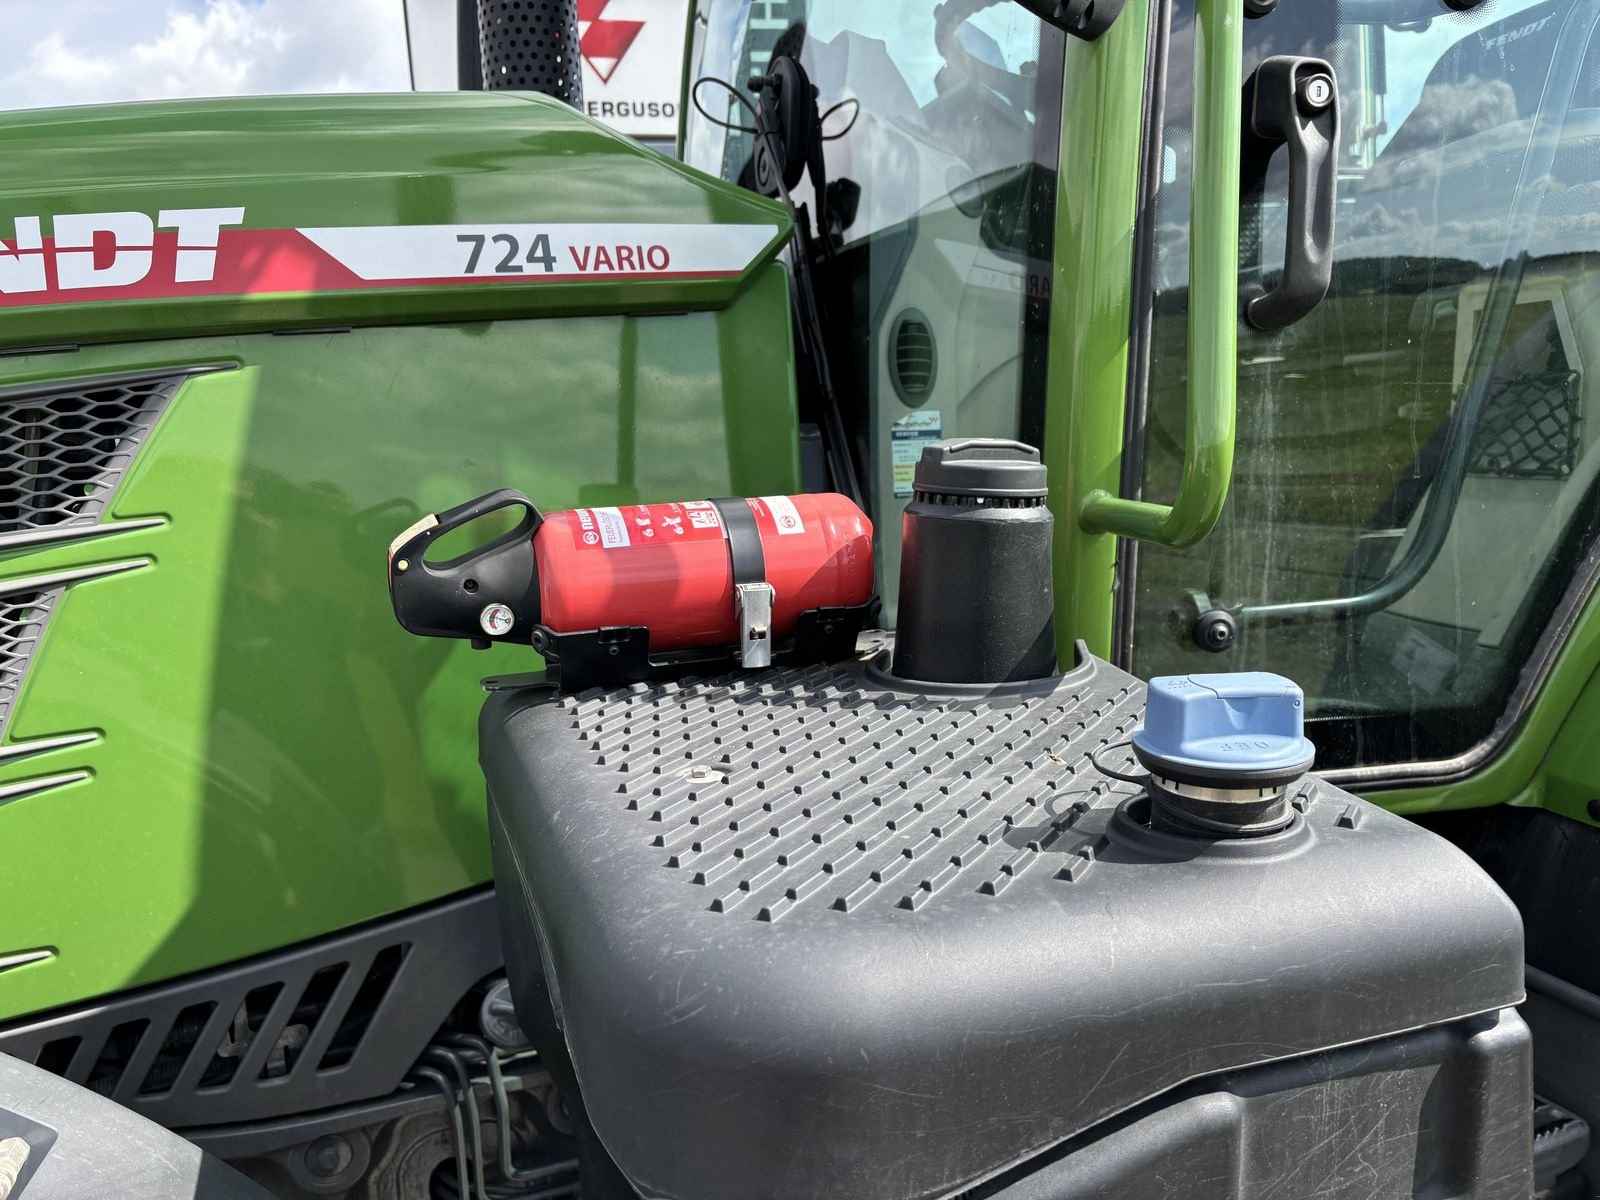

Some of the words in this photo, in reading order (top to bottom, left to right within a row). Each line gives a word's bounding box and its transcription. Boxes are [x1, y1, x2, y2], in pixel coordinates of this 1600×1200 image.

[1486, 15, 1552, 49] FENDT
[587, 101, 676, 118] ERGUSO
[0, 207, 245, 294] NDT
[456, 233, 557, 274] 724
[568, 244, 670, 272] VARIO
